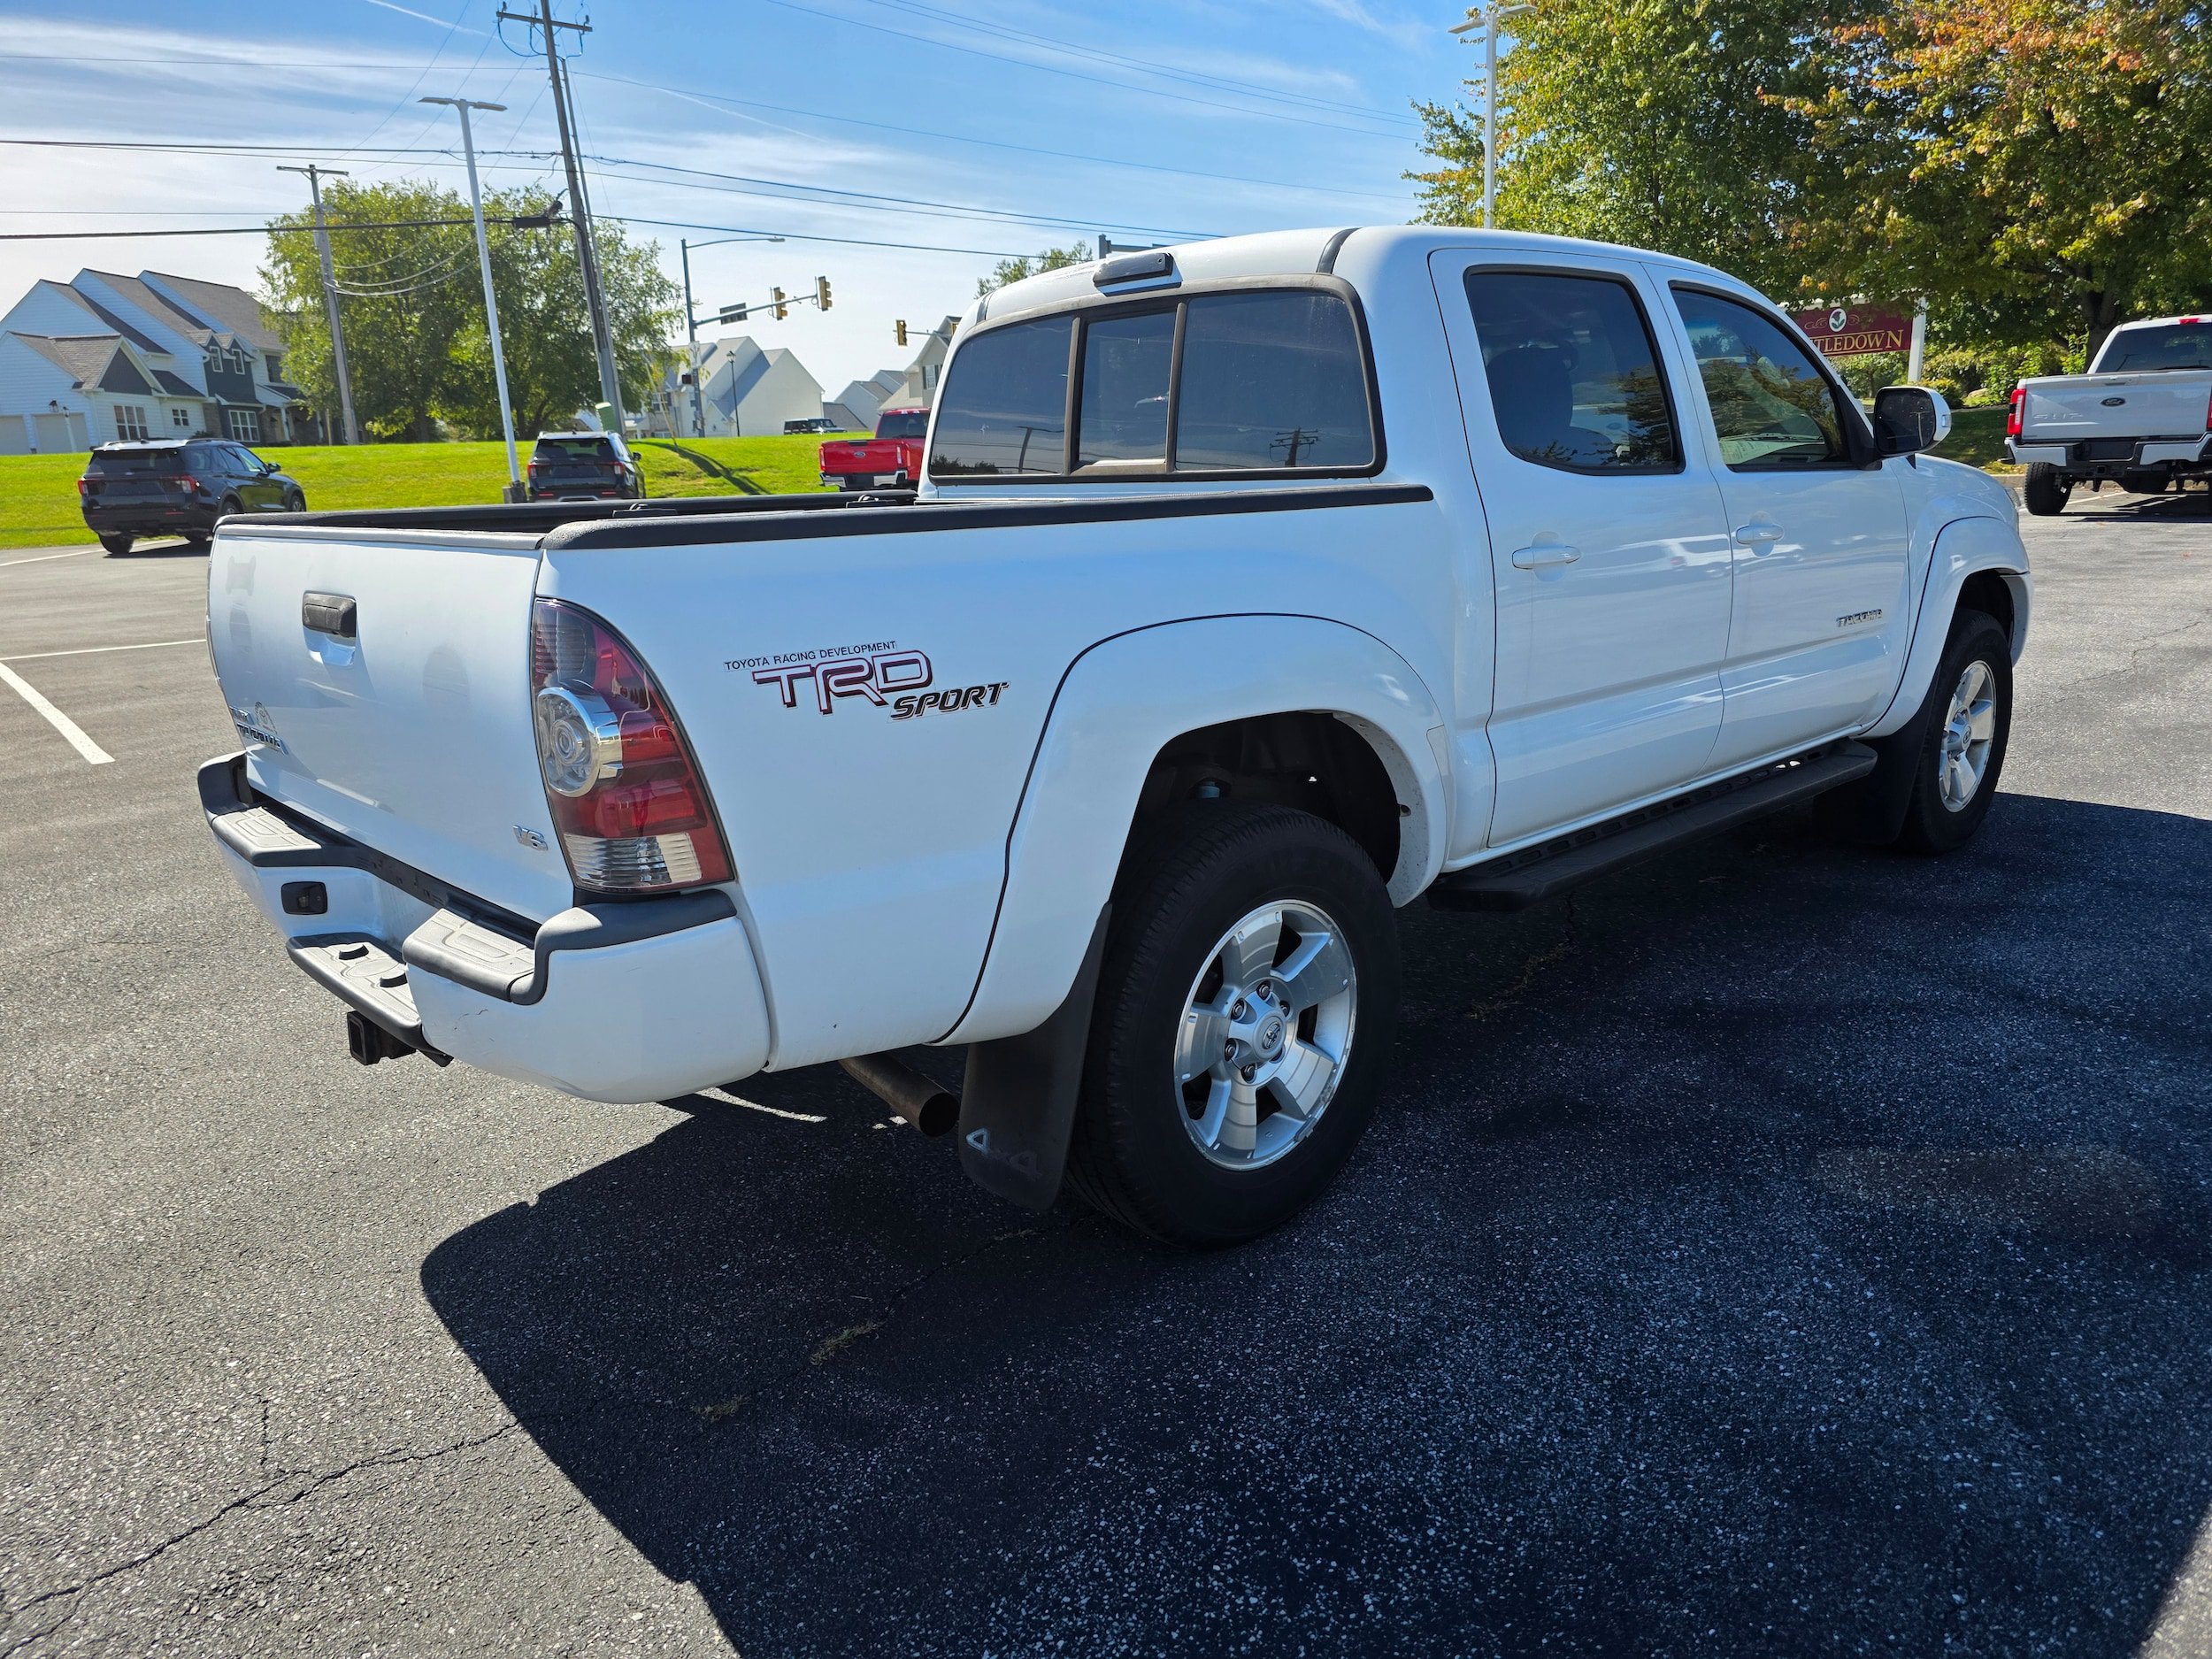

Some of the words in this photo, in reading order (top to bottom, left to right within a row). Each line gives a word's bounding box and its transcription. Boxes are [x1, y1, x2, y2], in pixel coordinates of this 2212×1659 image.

[1811, 329, 1904, 353] TLEDOWN
[725, 657, 770, 671] TOYOTA
[773, 651, 816, 664] RACING
[819, 641, 896, 658] DEVELOPMENT
[752, 649, 933, 715] TRD
[890, 682, 1010, 721] SPORT
[512, 825, 548, 850] V6
